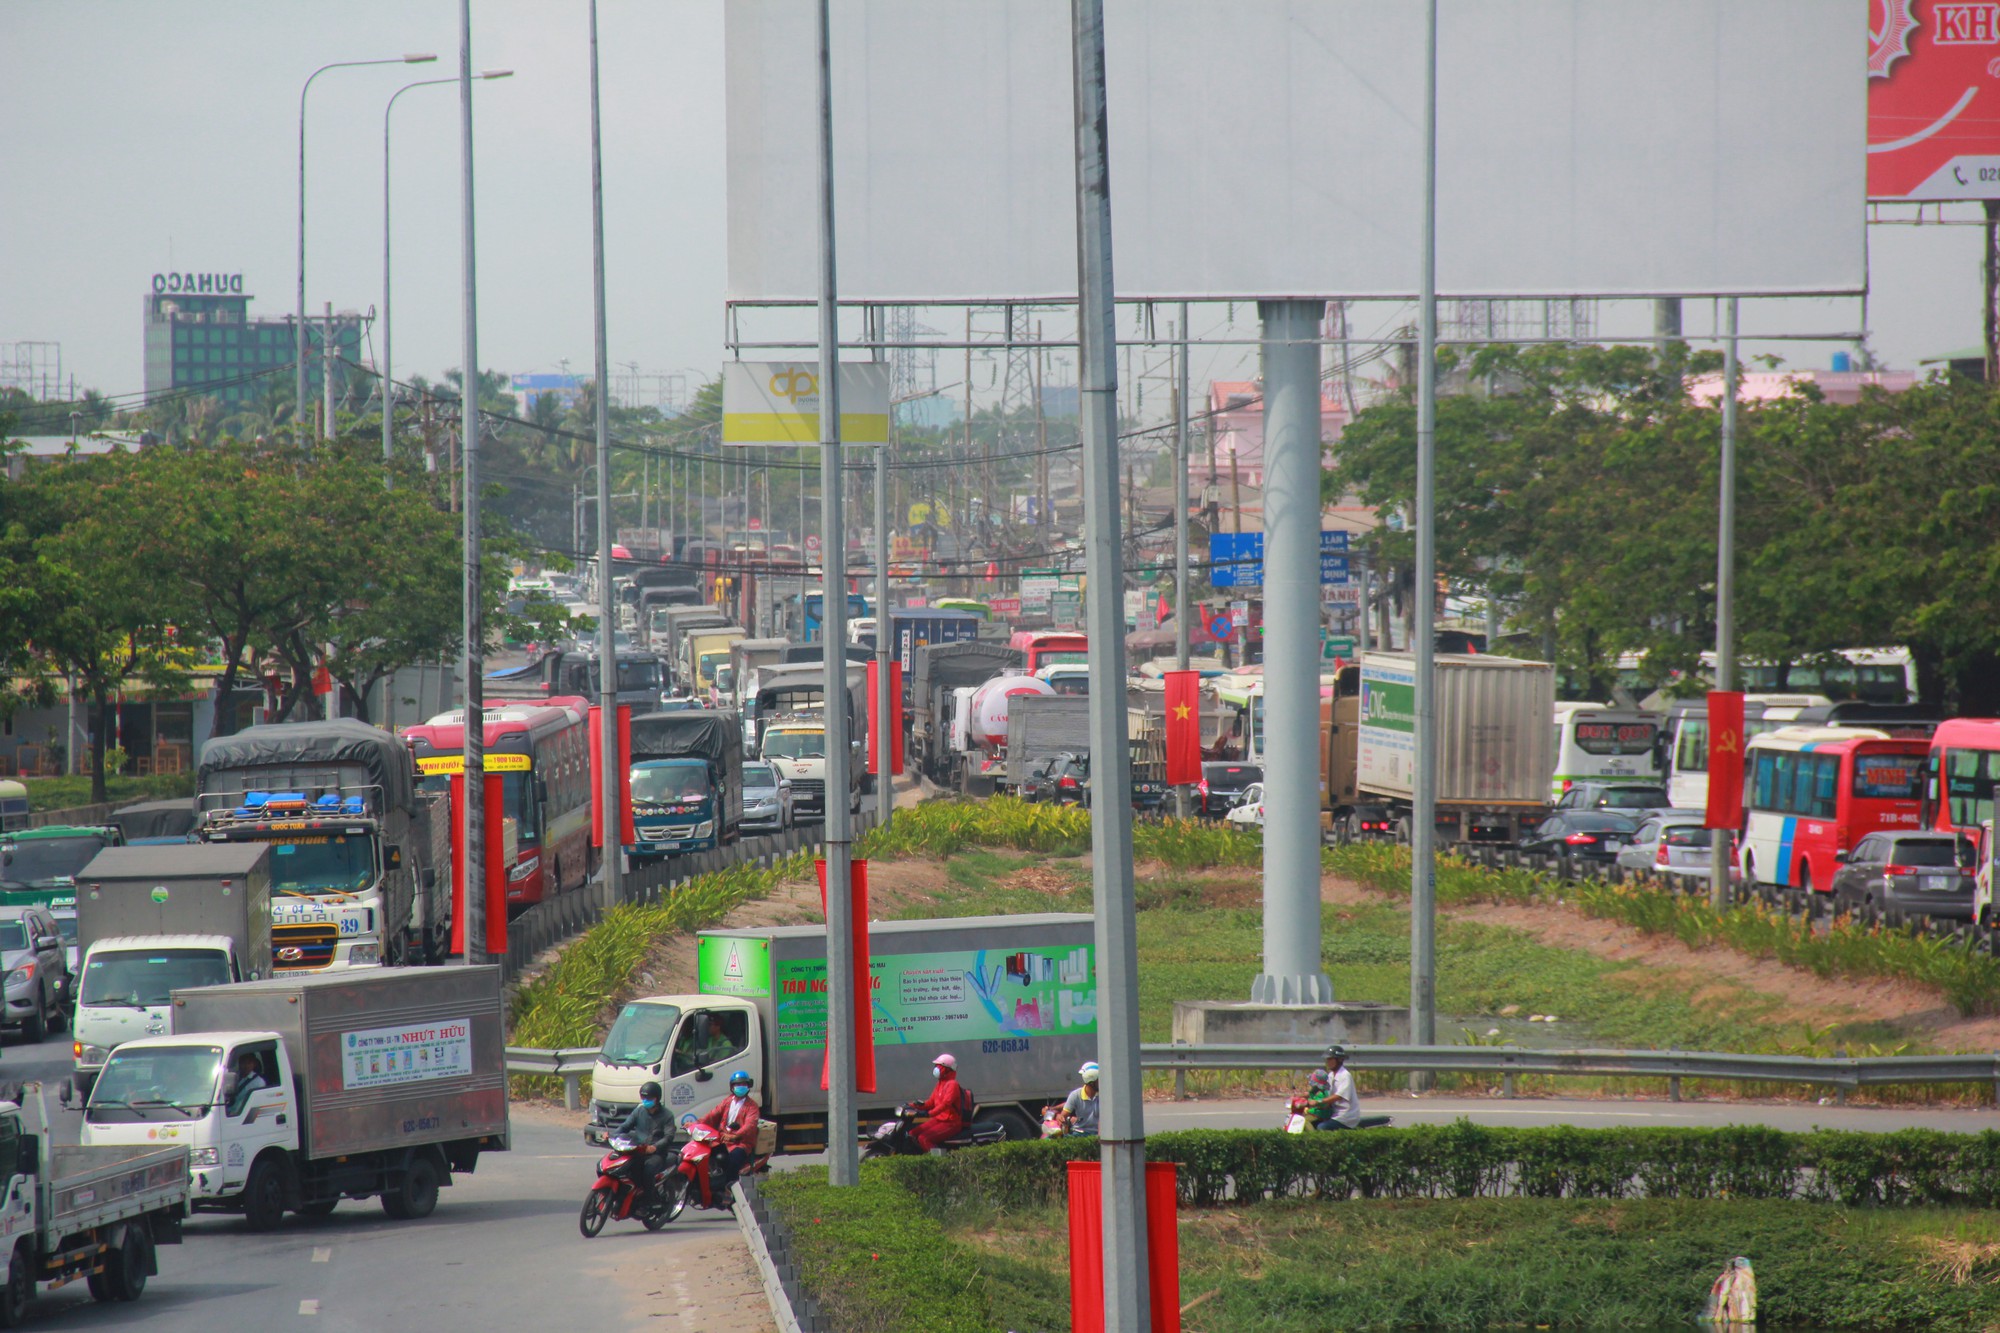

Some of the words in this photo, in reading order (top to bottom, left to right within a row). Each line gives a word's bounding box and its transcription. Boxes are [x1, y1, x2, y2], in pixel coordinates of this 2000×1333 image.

[1934, 3, 2000, 45] KH
[340, 918, 359, 934] 39
[782, 977, 807, 994] TÂN
[402, 1029, 435, 1043] NHỰT
[440, 1025, 466, 1038] HỮU
[982, 1038, 1030, 1053] 62C-058.34
